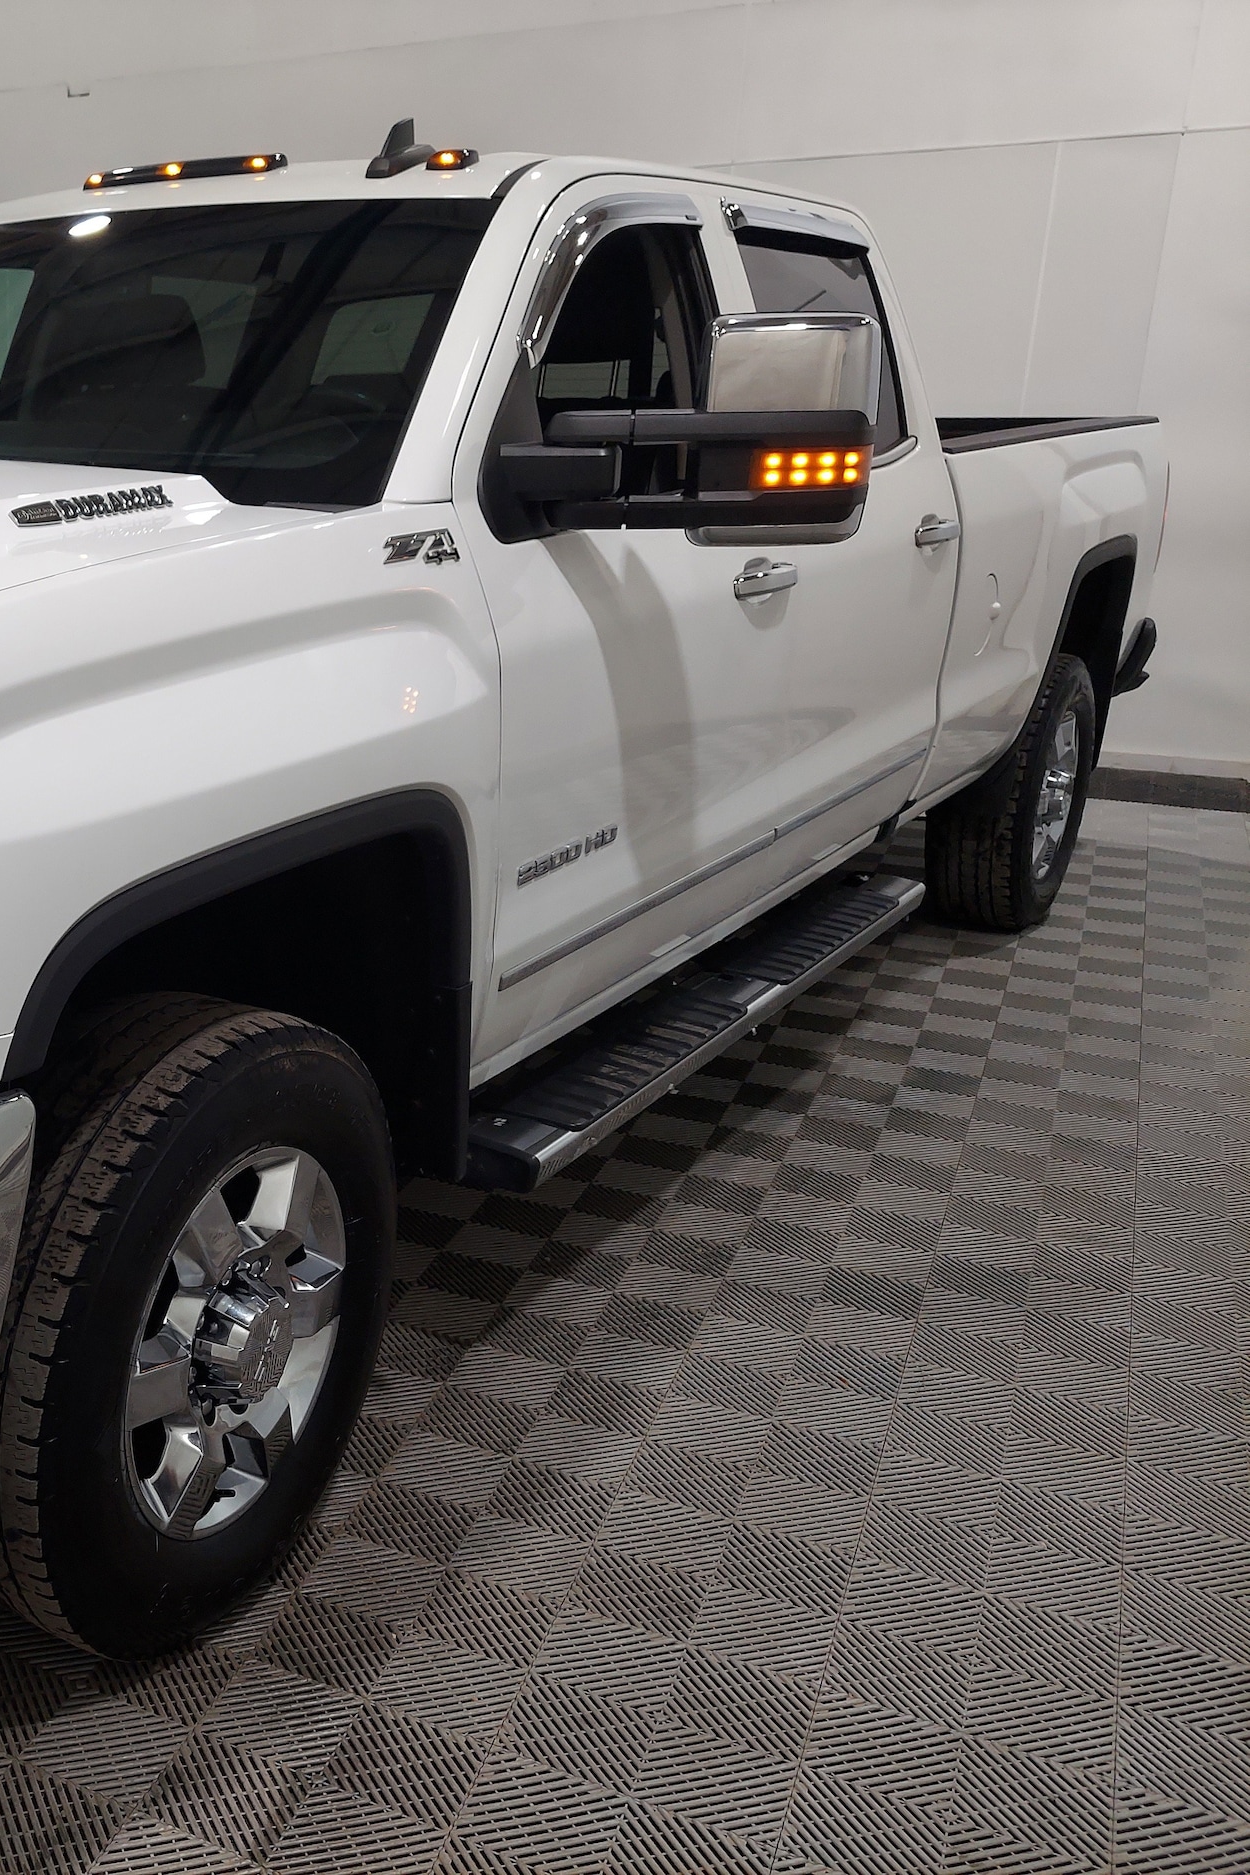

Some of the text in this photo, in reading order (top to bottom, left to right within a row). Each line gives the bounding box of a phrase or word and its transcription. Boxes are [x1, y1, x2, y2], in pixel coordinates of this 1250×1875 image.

[55, 485, 174, 522] DURAMAX
[517, 823, 618, 888] 2500 HD
